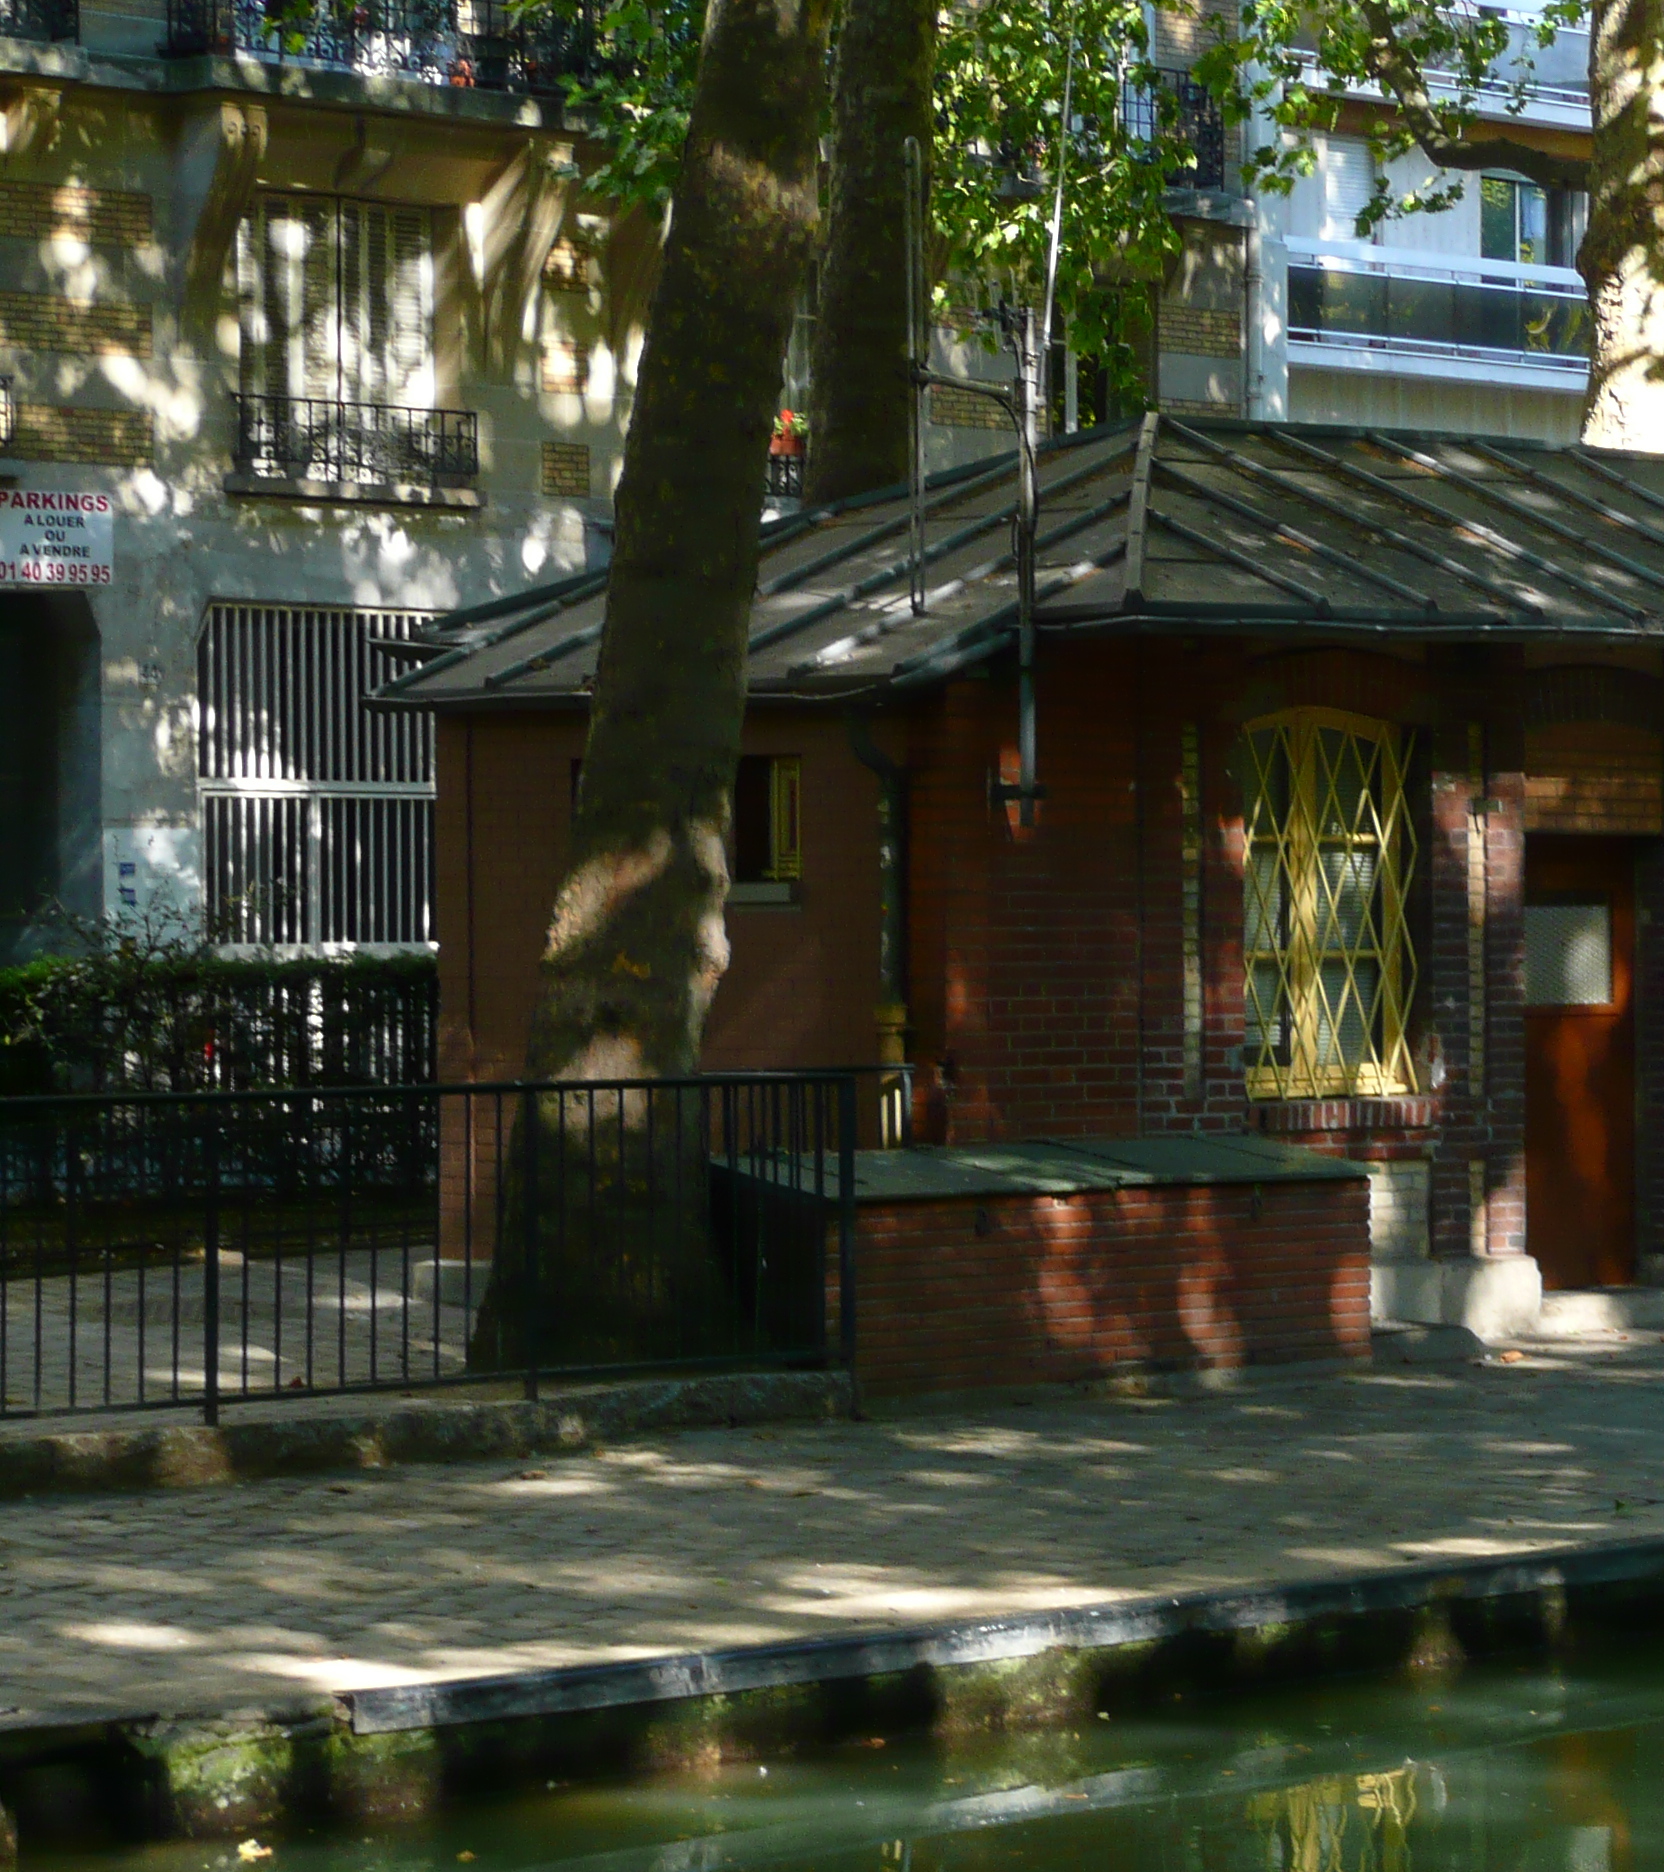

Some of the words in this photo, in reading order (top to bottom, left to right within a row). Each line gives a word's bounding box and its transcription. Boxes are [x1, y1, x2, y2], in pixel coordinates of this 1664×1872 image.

[0, 491, 109, 512] PARKINGS
[24, 514, 34, 525] A
[37, 514, 86, 529] LOUER
[45, 530, 66, 542] OU
[20, 544, 30, 556] A
[32, 543, 91, 558] VENDRE
[22, 562, 41, 581] 40
[46, 563, 65, 582] 39
[69, 563, 88, 583] 95
[91, 564, 111, 584] 95
